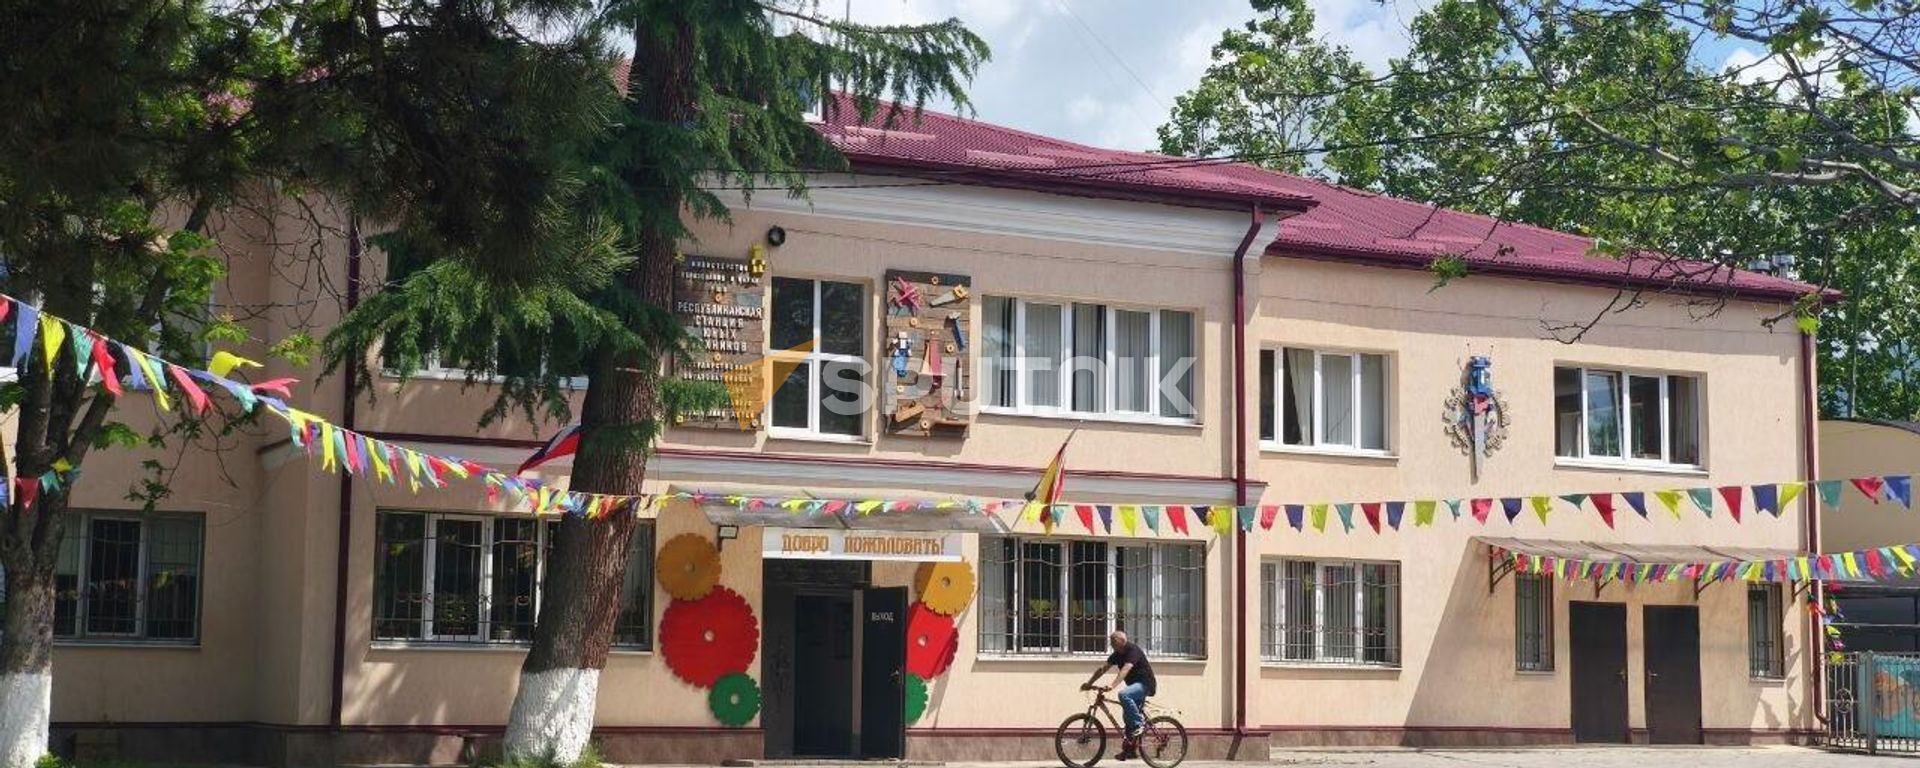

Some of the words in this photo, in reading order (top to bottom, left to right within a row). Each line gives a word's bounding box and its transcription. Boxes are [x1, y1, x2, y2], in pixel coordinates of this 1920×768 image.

[677, 301, 762, 318] РЕСПУБЛИКАНСКАЯ
[695, 315, 744, 328] СТАНЦИЯ
[703, 327, 737, 339] ЮНЫХ
[703, 338, 748, 352] ХНИКОВ
[782, 535, 829, 553] ДОБРО
[843, 536, 945, 555] ПОЖАЛОВАТЬ!
[872, 611, 894, 623] ВЫХОД
